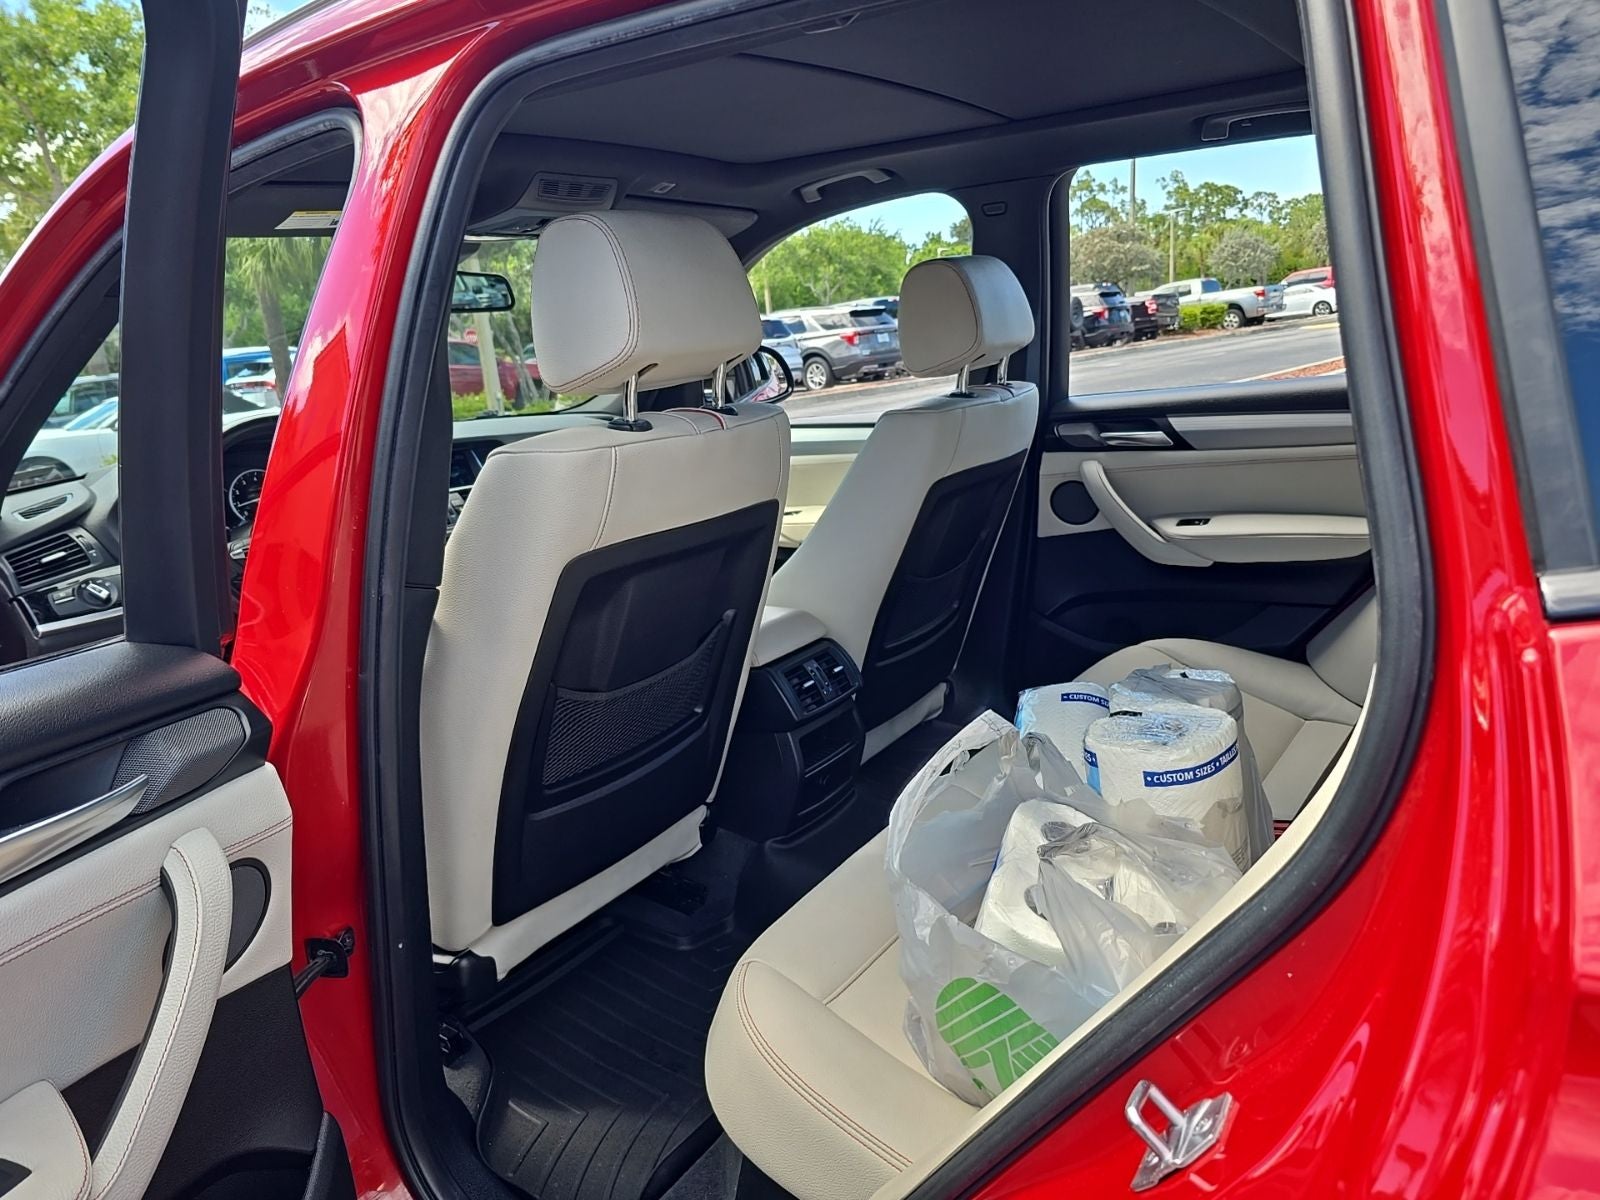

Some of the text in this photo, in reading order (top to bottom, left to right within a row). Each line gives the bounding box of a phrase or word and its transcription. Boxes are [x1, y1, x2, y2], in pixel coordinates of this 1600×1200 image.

[1069, 693, 1100, 703] CUSTOM
[1153, 770, 1194, 783] CUSTOM
[1195, 761, 1216, 778] SIZES
